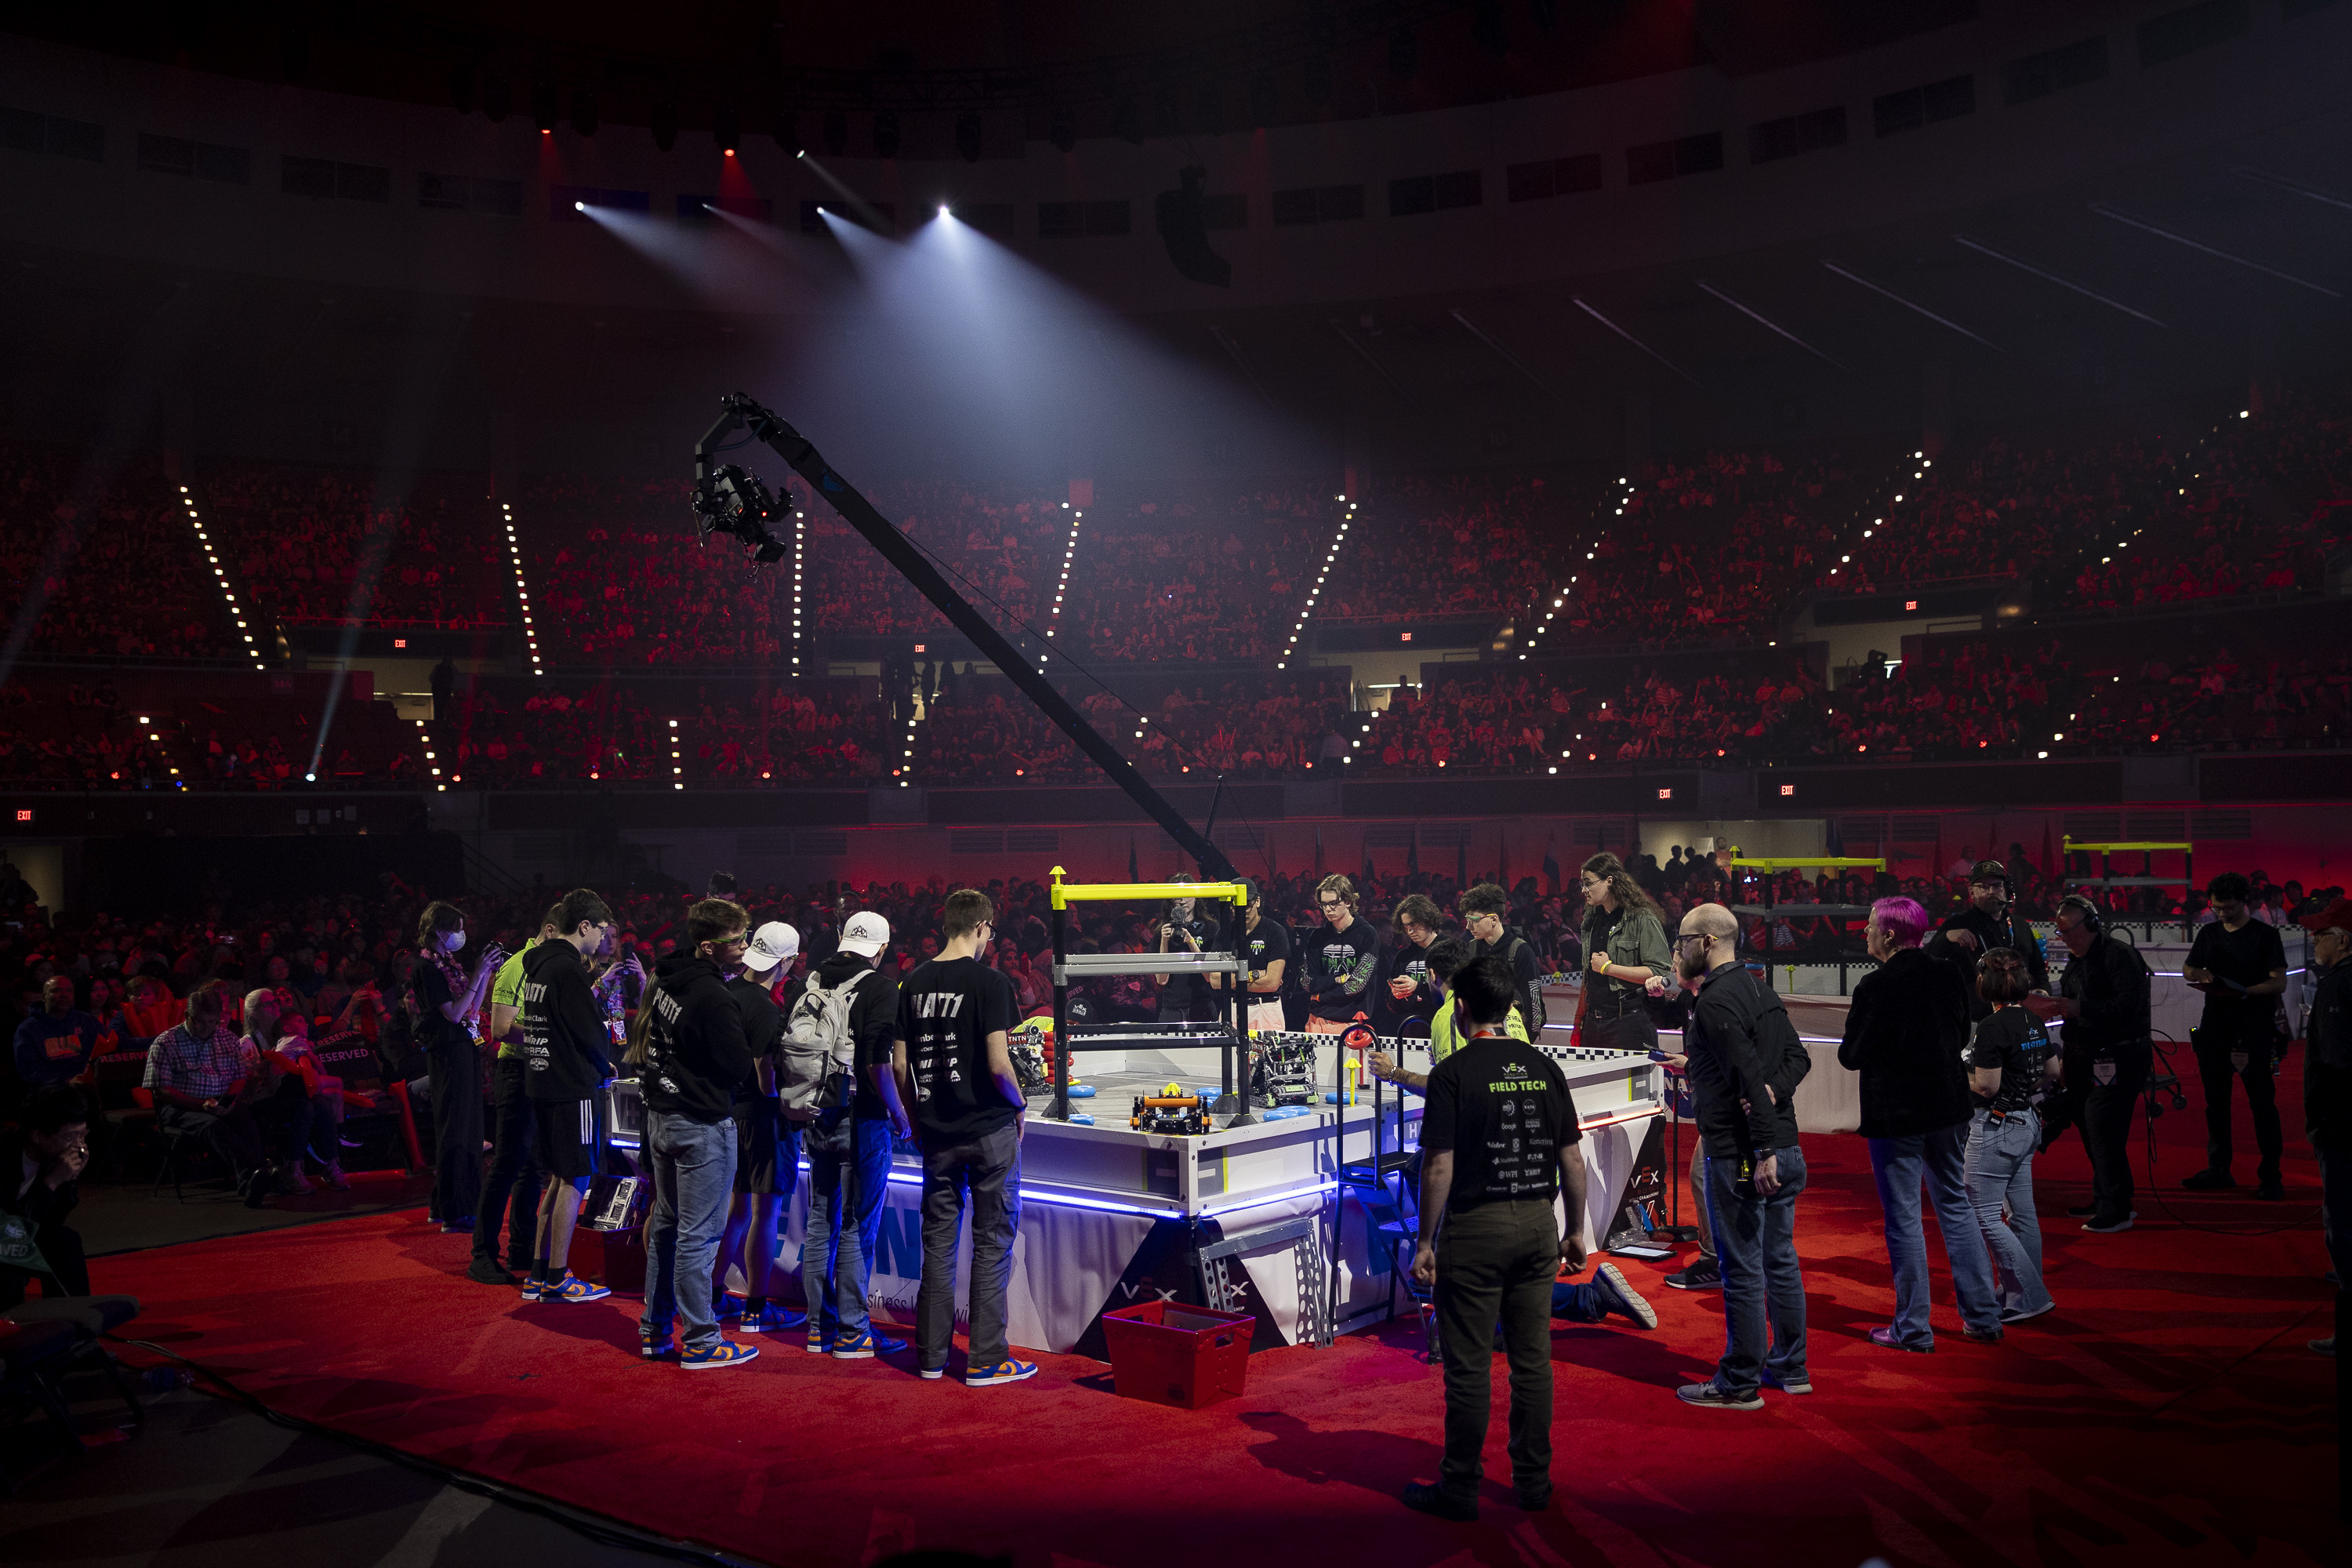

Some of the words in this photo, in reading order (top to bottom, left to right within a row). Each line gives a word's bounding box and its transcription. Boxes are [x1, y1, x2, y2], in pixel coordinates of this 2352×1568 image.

[1906, 601, 1917, 610] EXIT
[394, 639, 406, 648] EXIT
[1659, 789, 1671, 799] EXIT
[1781, 785, 1793, 795] EXIT
[17, 810, 31, 821] EXIT
[318, 1047, 369, 1063] ESERVED
[1501, 1062, 1527, 1073] VEX
[1488, 1081, 1518, 1093] FIELD
[1518, 1080, 1547, 1091] TECH
[1630, 1166, 1659, 1189] VEX
[1121, 1276, 1178, 1302] VEX
